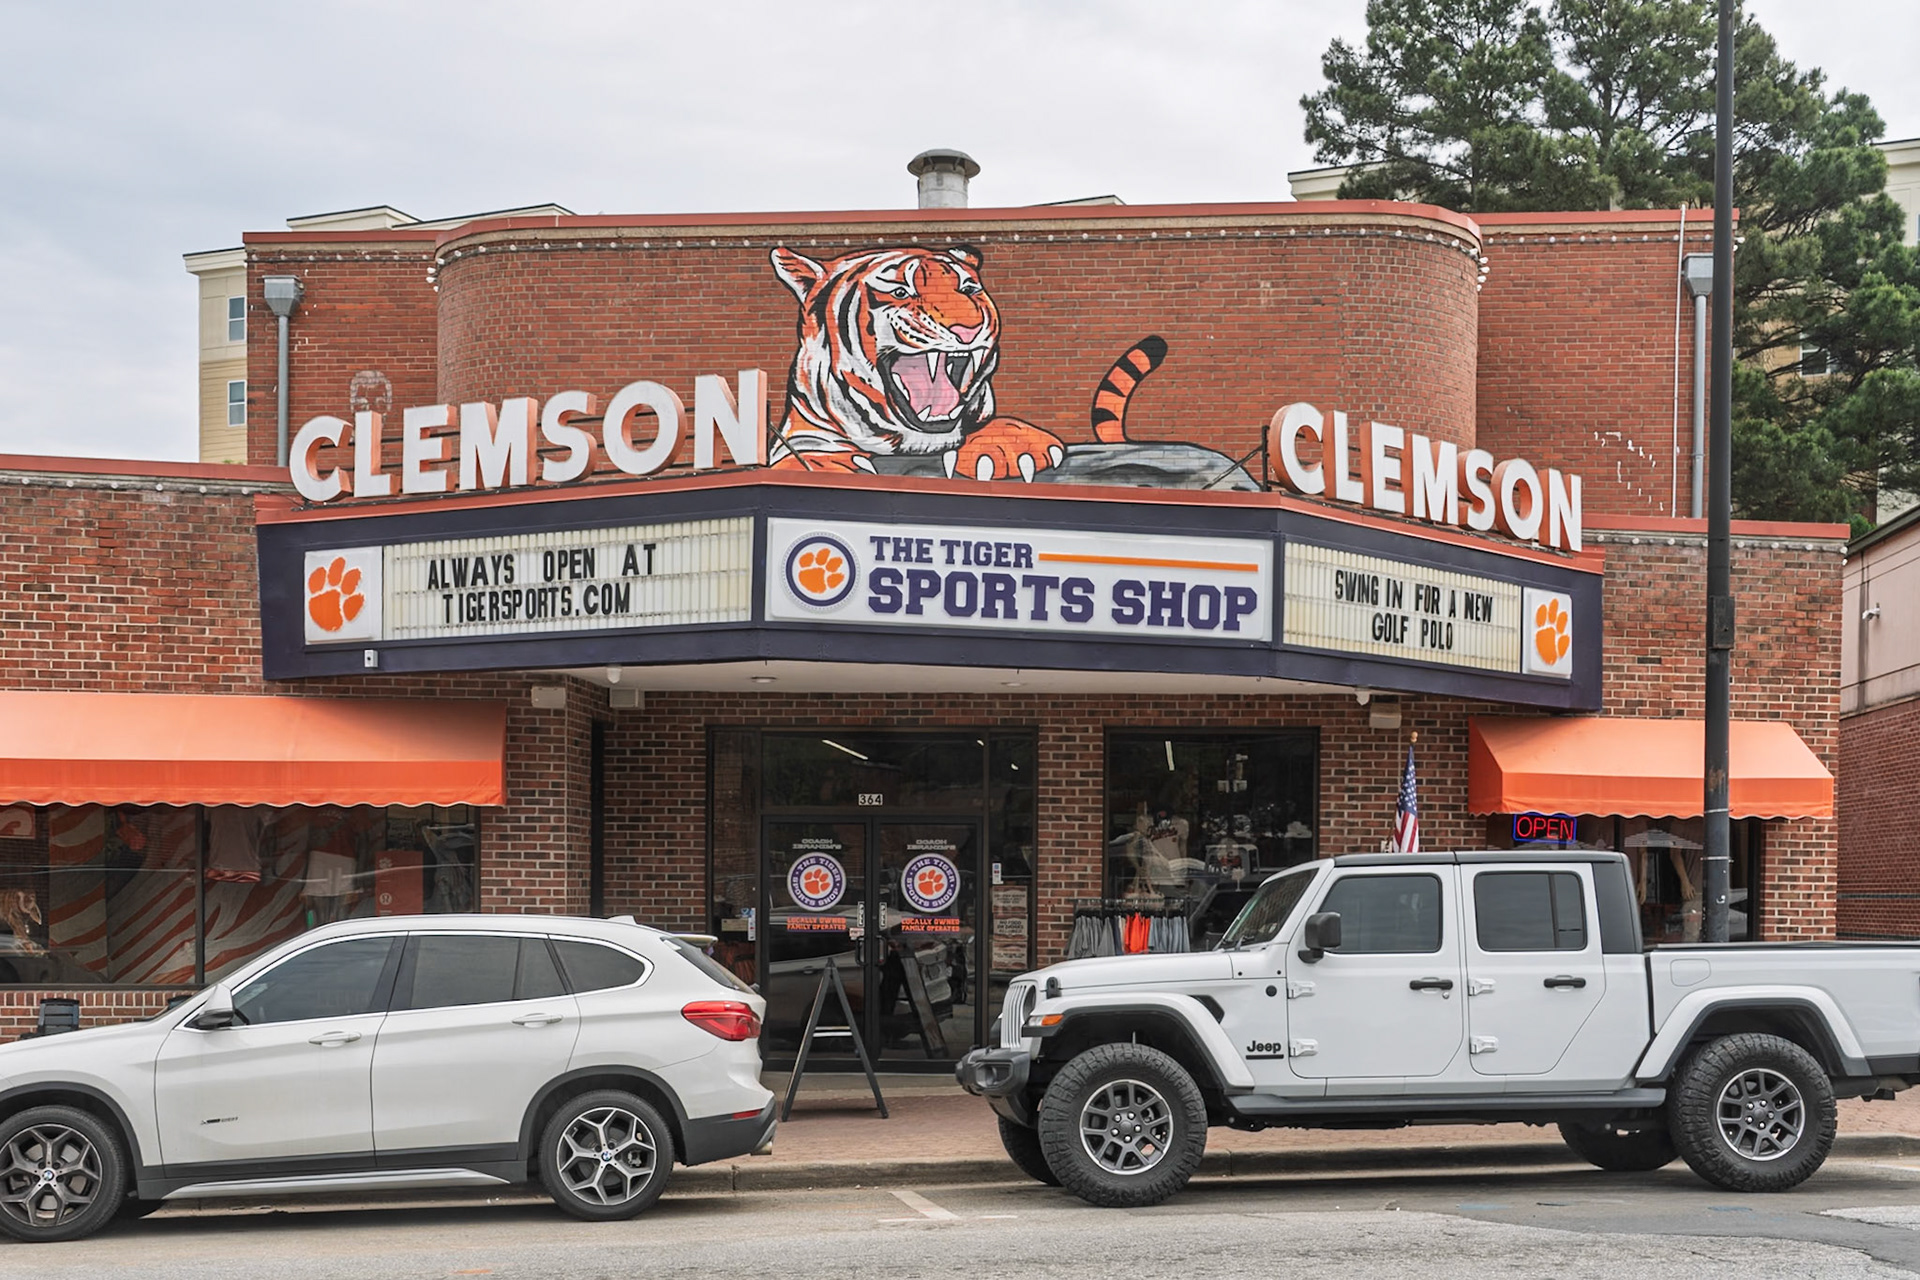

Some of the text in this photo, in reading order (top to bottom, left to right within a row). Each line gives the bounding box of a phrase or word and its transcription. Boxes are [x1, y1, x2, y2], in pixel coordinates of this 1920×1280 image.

[289, 368, 767, 502] CLEMSON
[1269, 402, 1582, 552] CLEMSON
[427, 543, 657, 590] ALWAYS OPEN AT
[869, 535, 1033, 569] THE TIGER
[442, 582, 630, 624] TIGERSPORTS.COM
[868, 567, 1258, 631] SPORTS SHOP
[1335, 570, 1493, 623] SWING IN FOR A NEW
[1372, 612, 1453, 650] GOLF POLO
[860, 794, 881, 805] 364
[1516, 816, 1574, 840] OPEN
[797, 858, 841, 881] THE TIGER
[911, 858, 955, 882] THE TIGER
[792, 876, 839, 906] SPORTS SHOP
[906, 877, 953, 907] SPORTS SHOP
[1246, 1040, 1282, 1054] Jeep
